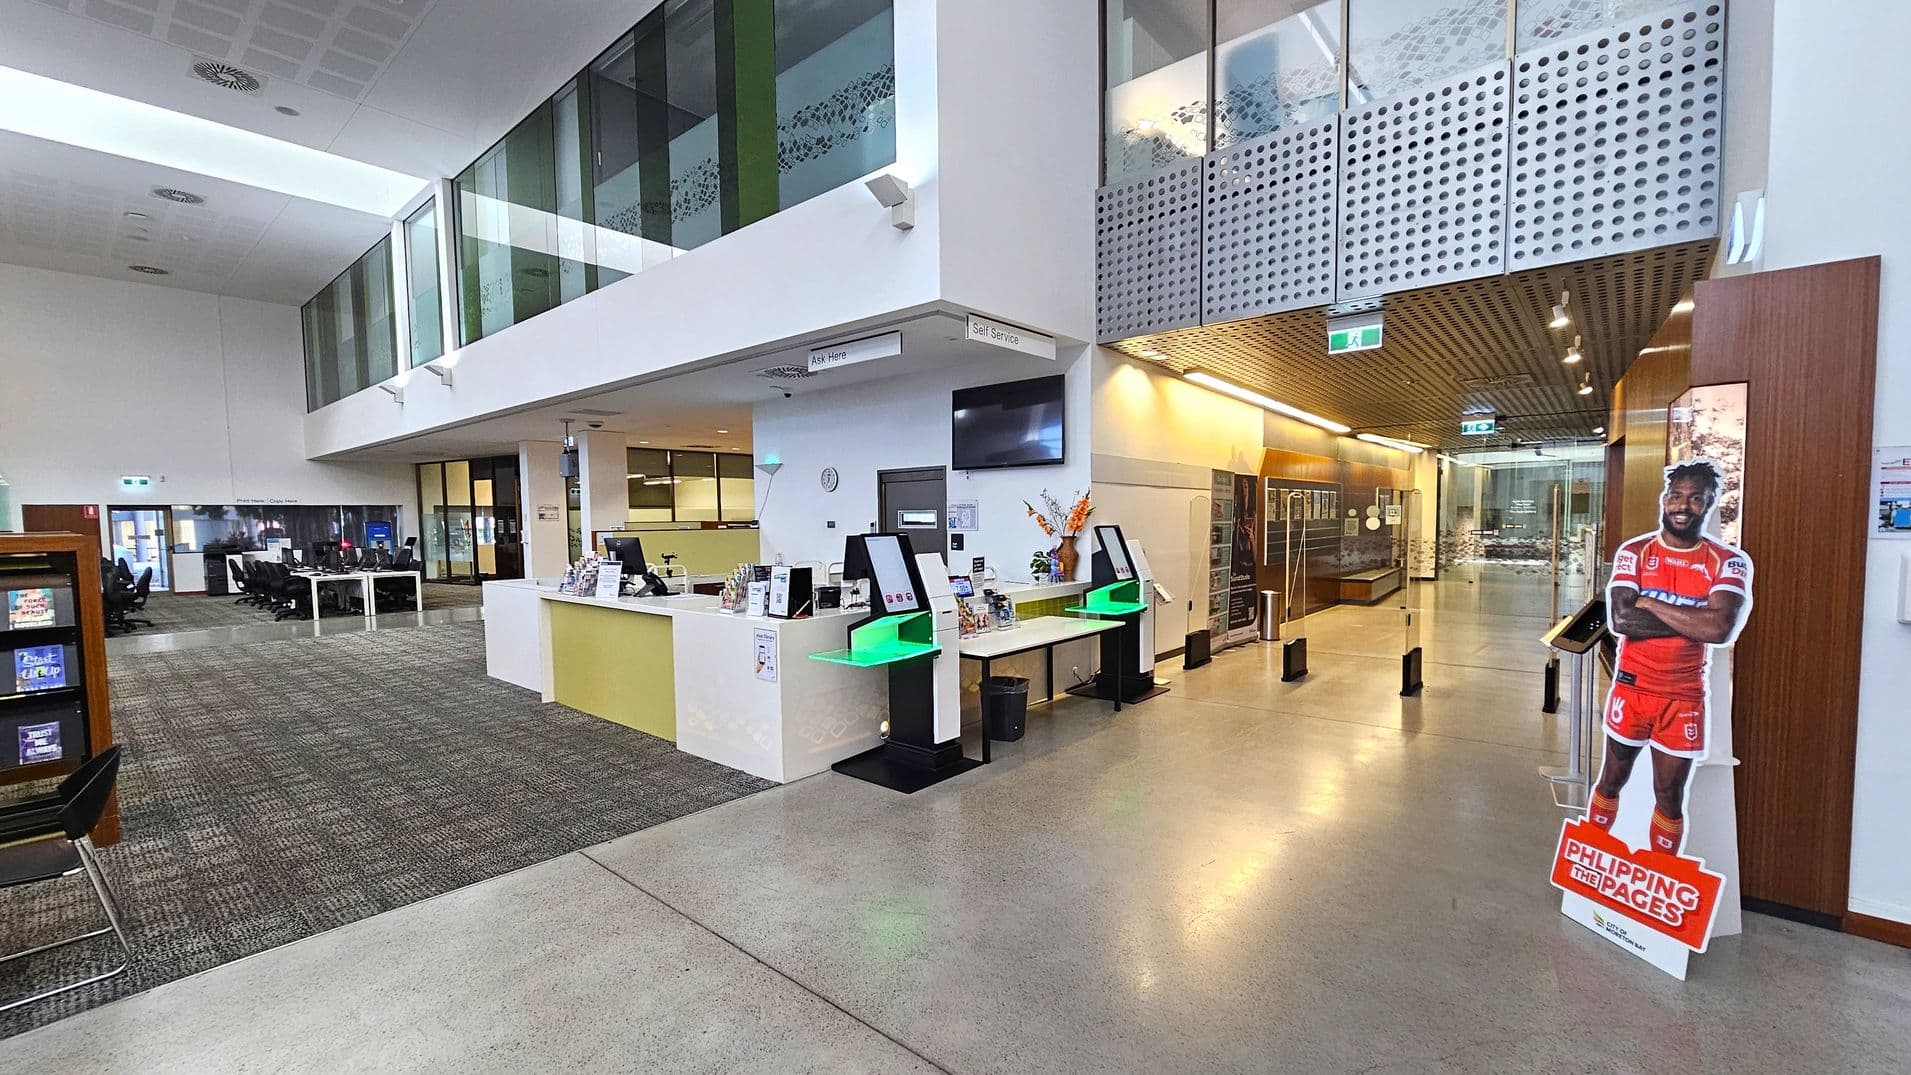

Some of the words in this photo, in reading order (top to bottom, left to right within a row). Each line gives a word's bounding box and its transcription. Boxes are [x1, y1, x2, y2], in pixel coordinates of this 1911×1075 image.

[973, 322, 989, 337] Self
[990, 327, 1019, 345] Service
[811, 354, 826, 366] Ask
[828, 351, 847, 363] Here
[1566, 840, 1699, 909] PHLIPPING
[1573, 866, 1598, 887] THE
[1600, 874, 1684, 926] PAGES
[1605, 927, 1634, 946] MORETON
[1634, 942, 1647, 952] BAY
[1606, 921, 1619, 930] CITY
[1619, 928, 1628, 936] OF
